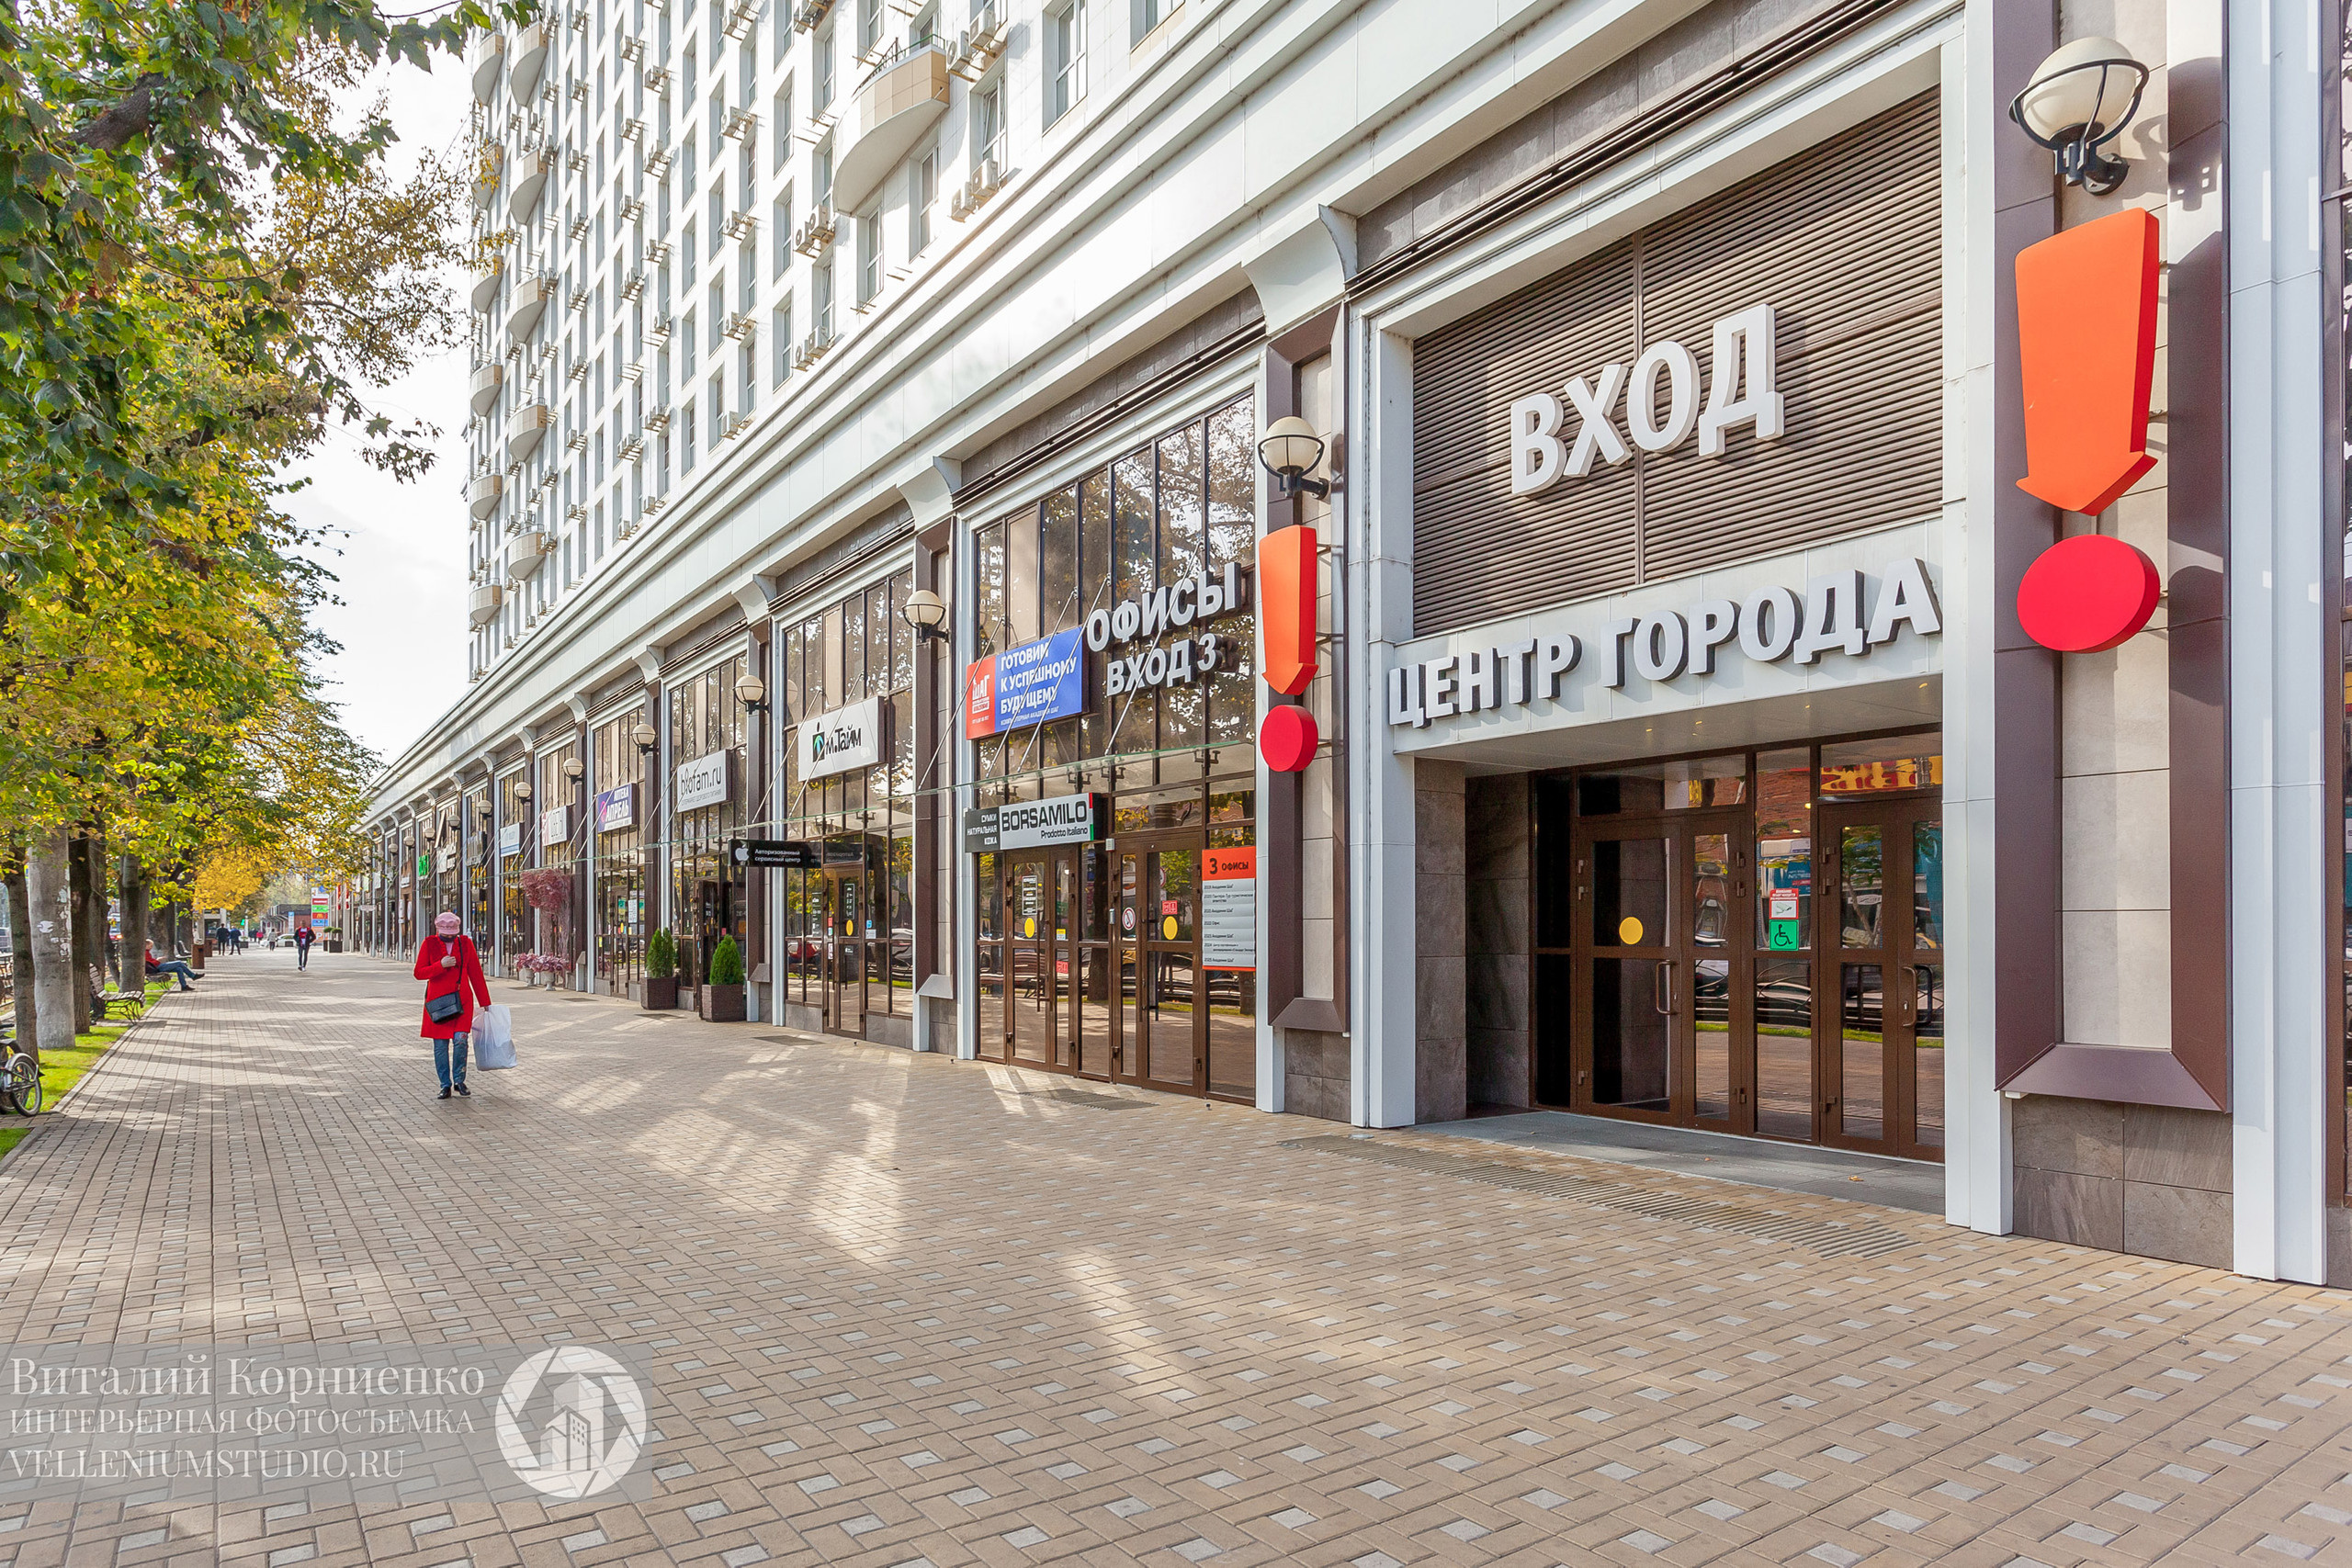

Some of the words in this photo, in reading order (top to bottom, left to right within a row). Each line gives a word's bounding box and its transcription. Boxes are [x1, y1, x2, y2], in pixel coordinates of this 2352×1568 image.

[1510, 303, 1784, 496] ВХОД
[1087, 561, 1238, 652] ОФИСЫ
[1001, 642, 1049, 671] ГОТОВИМ
[1389, 633, 1580, 728] ЦЕНТР
[1600, 558, 1942, 688] ГОРОДА
[1001, 677, 1008, 693] К
[1009, 657, 1078, 690] УСПЕШНОМУ
[1107, 639, 1192, 696] ВХОД
[1197, 633, 1217, 671] 3
[1001, 686, 1057, 715] БУДУЩЕМУ
[605, 799, 629, 823] АПРЕЛЬ
[1001, 800, 1088, 831] BORSAMILO
[967, 825, 998, 836] НАТУРАЛЬНАЯ
[1041, 829, 1066, 840] Prodotto
[1067, 826, 1088, 837] Italiano
[1209, 857, 1218, 875] 3
[1221, 862, 1250, 872] ОФИСЫ
